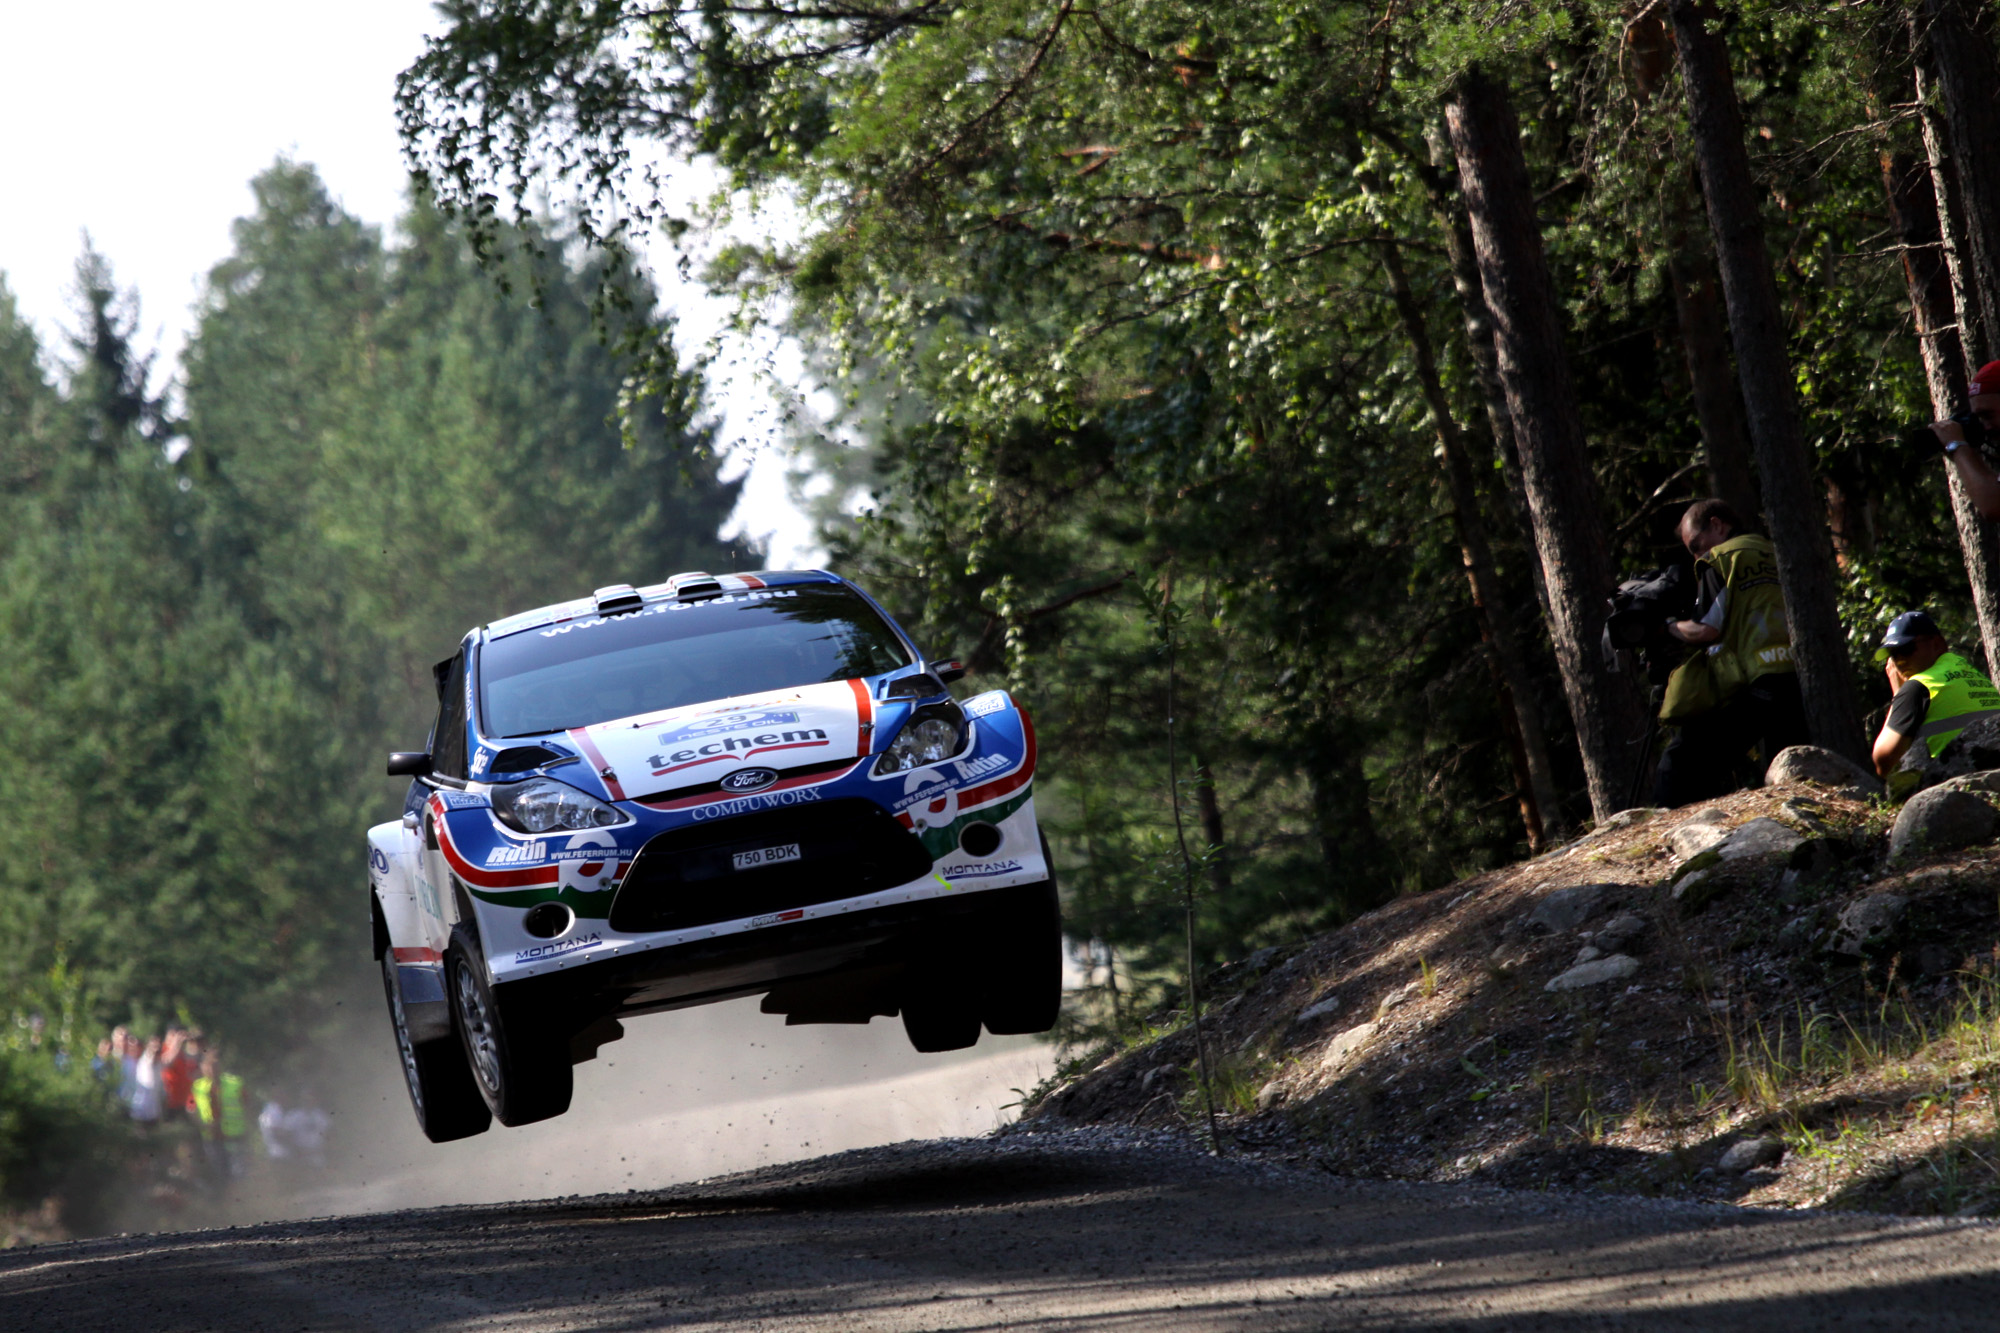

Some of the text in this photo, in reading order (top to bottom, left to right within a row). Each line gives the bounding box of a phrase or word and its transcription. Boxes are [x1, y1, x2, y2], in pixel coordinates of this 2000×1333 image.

[540, 589, 798, 638] www.ford.hu
[706, 714, 748, 728] 29
[752, 718, 784, 728] OIL
[646, 728, 827, 769] techem
[953, 752, 1010, 781] Rutin
[733, 771, 764, 787] Ford
[692, 787, 822, 821] COMPUWORX
[485, 839, 547, 863] Rutin
[551, 849, 633, 861] WWW.FEFERRUM.HU
[735, 843, 798, 866] 750 BDK
[942, 860, 1019, 876] MONTANA
[515, 932, 601, 960] MONTANA
